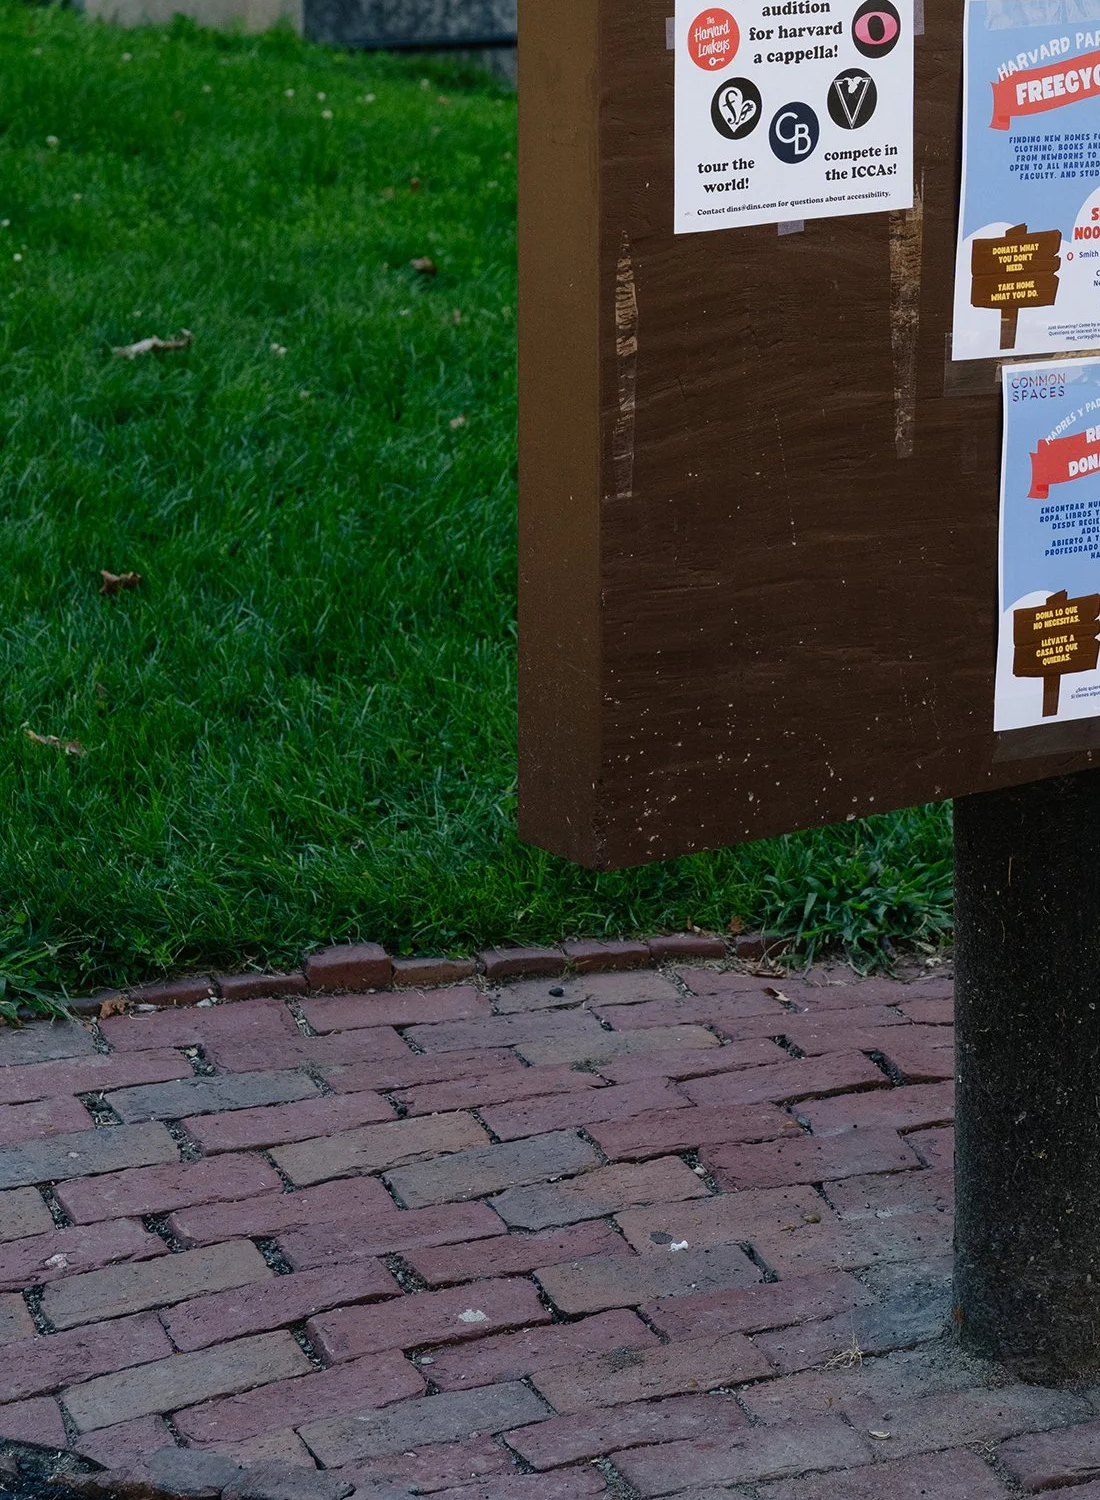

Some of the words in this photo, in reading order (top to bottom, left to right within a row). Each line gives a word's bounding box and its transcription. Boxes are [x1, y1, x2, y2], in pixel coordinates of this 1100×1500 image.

[762, 1, 830, 17] audition
[749, 27, 773, 41] for
[778, 21, 843, 38] harvard
[754, 52, 762, 64] a
[767, 45, 838, 65] cappella!
[997, 36, 1070, 82] HARVARD
[697, 206, 725, 216] Contact
[726, 200, 776, 214] dins@dins.com
[778, 199, 789, 207] for
[790, 196, 824, 207] questions
[825, 194, 845, 202] about
[847, 190, 891, 202] accessibility.
[1079, 250, 1099, 259] Smith
[1012, 373, 1066, 389] COMMON
[1012, 386, 1065, 402] SPACES
